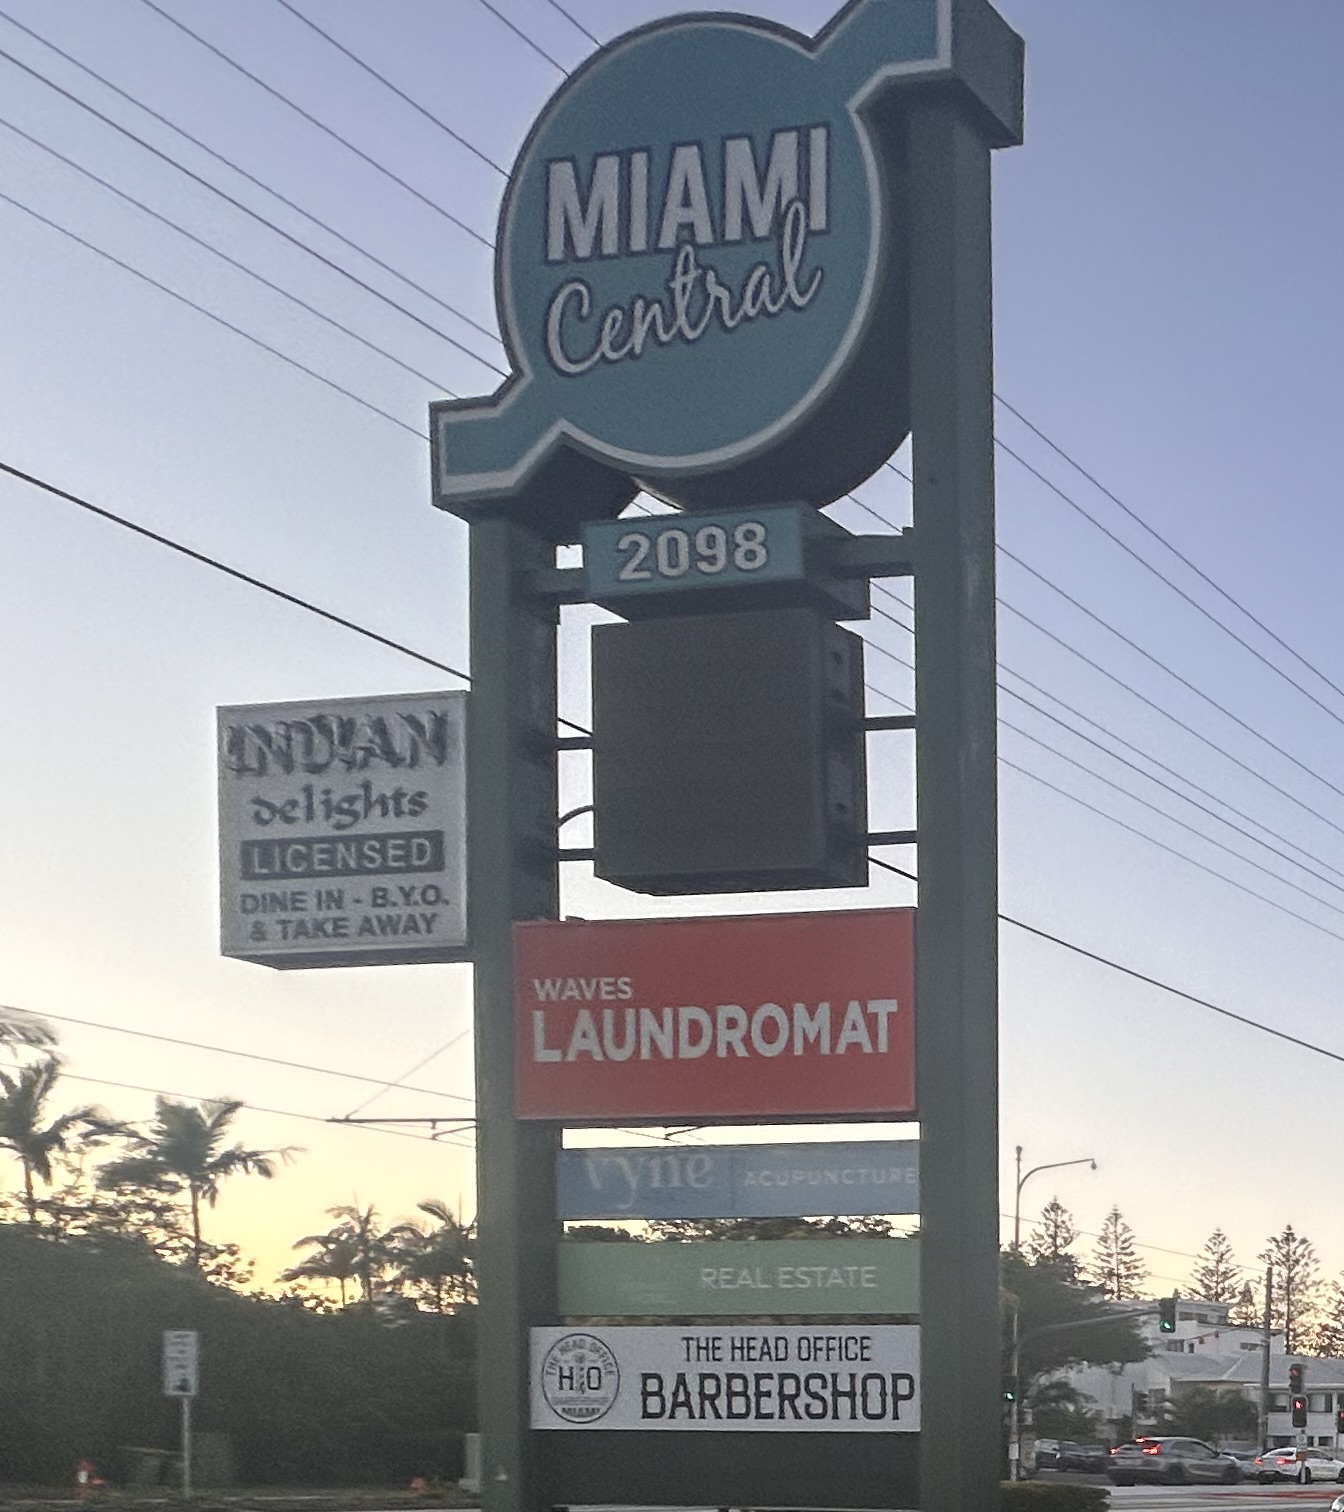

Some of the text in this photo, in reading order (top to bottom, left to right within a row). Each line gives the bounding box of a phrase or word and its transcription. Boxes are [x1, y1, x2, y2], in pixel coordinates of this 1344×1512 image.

[547, 127, 828, 260] MIAMI
[547, 202, 822, 373] Central
[617, 522, 768, 580] 2098
[227, 710, 449, 775] INDIAN
[250, 778, 429, 831] delights
[253, 838, 432, 873] LICENSED
[240, 891, 306, 914] DINE
[316, 889, 344, 909] IN
[250, 913, 437, 940] & TAKE AWAY
[534, 977, 632, 1000] WAVES
[532, 1000, 897, 1064] LAUNDROMAT
[703, 1267, 877, 1289] REAL ESTATE
[681, 1336, 872, 1361] THE HEAD OFFICE
[641, 1373, 915, 1419] BARBERSHOP
